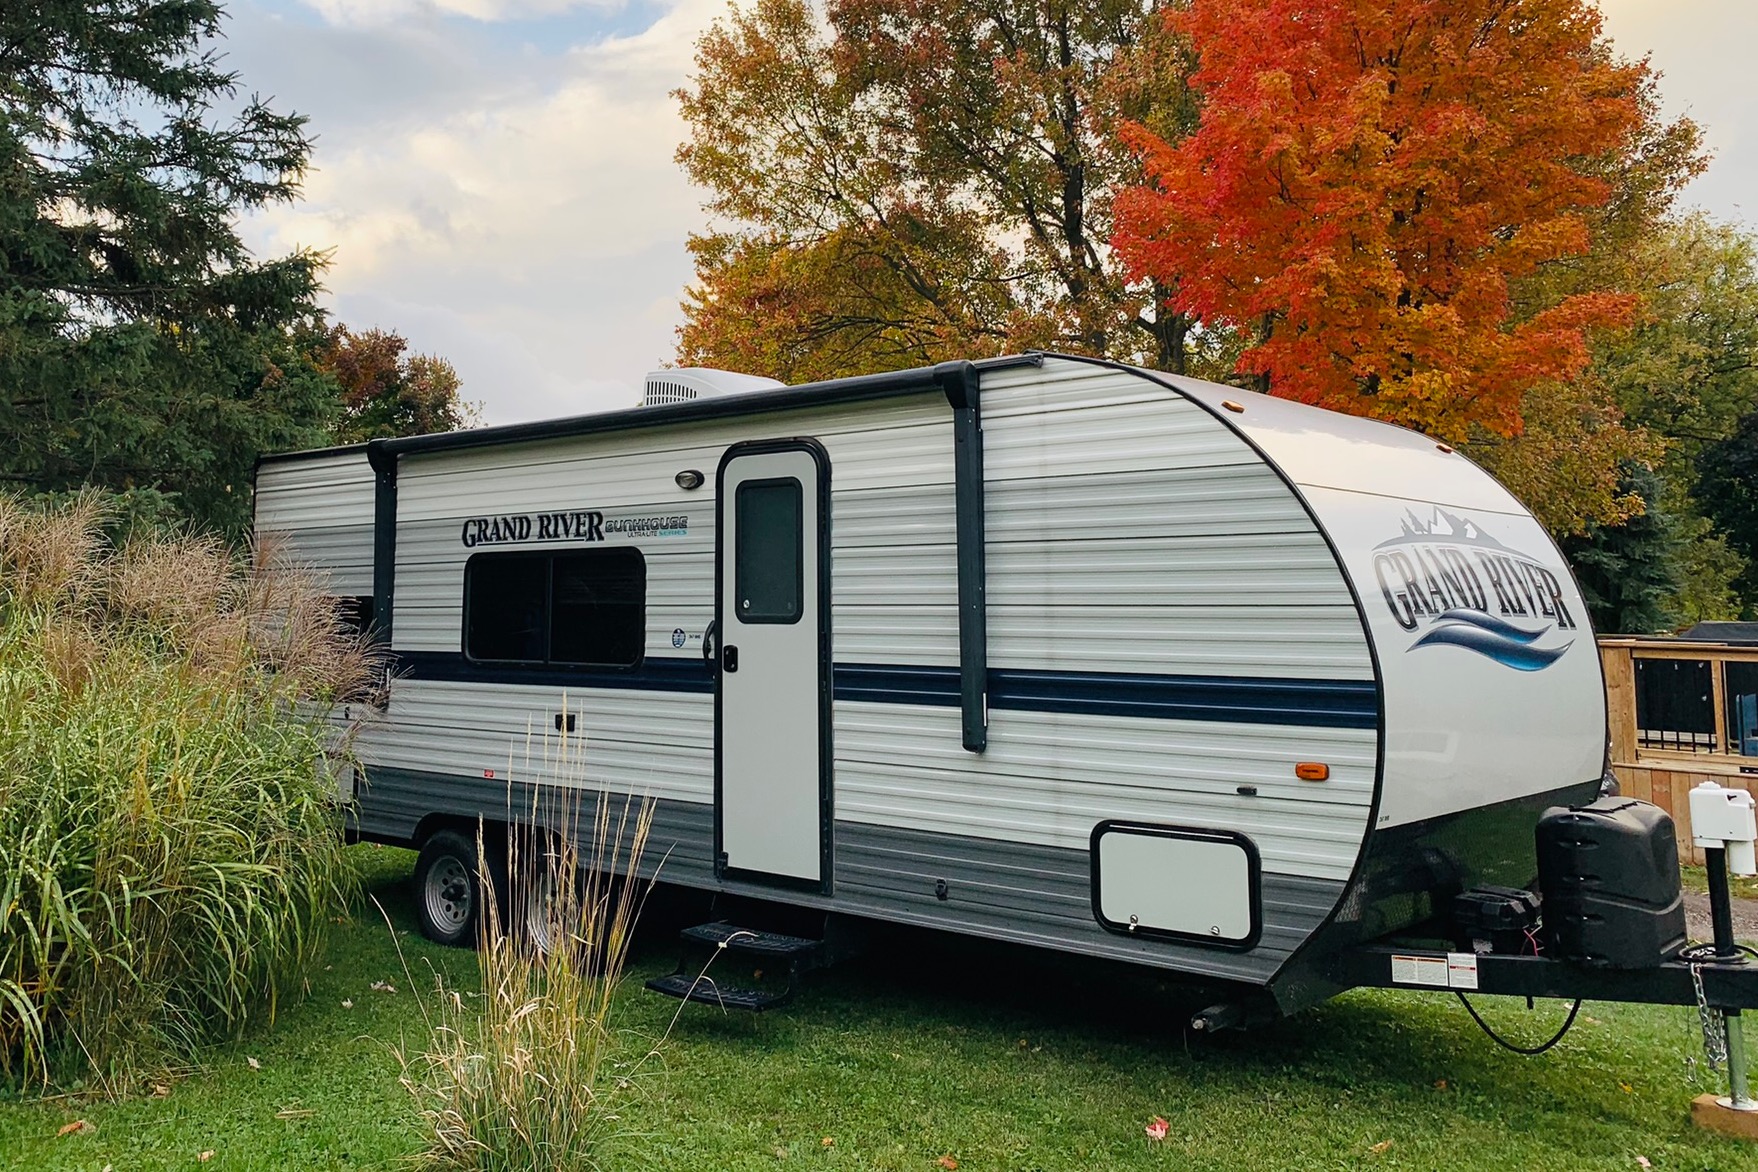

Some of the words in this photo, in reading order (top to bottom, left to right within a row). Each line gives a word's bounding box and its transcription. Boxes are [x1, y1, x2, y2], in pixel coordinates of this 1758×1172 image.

[462, 514, 531, 547] GRAND
[537, 511, 605, 541] RIVER
[1373, 546, 1488, 633] GRAND
[1472, 548, 1577, 631] RIVER
